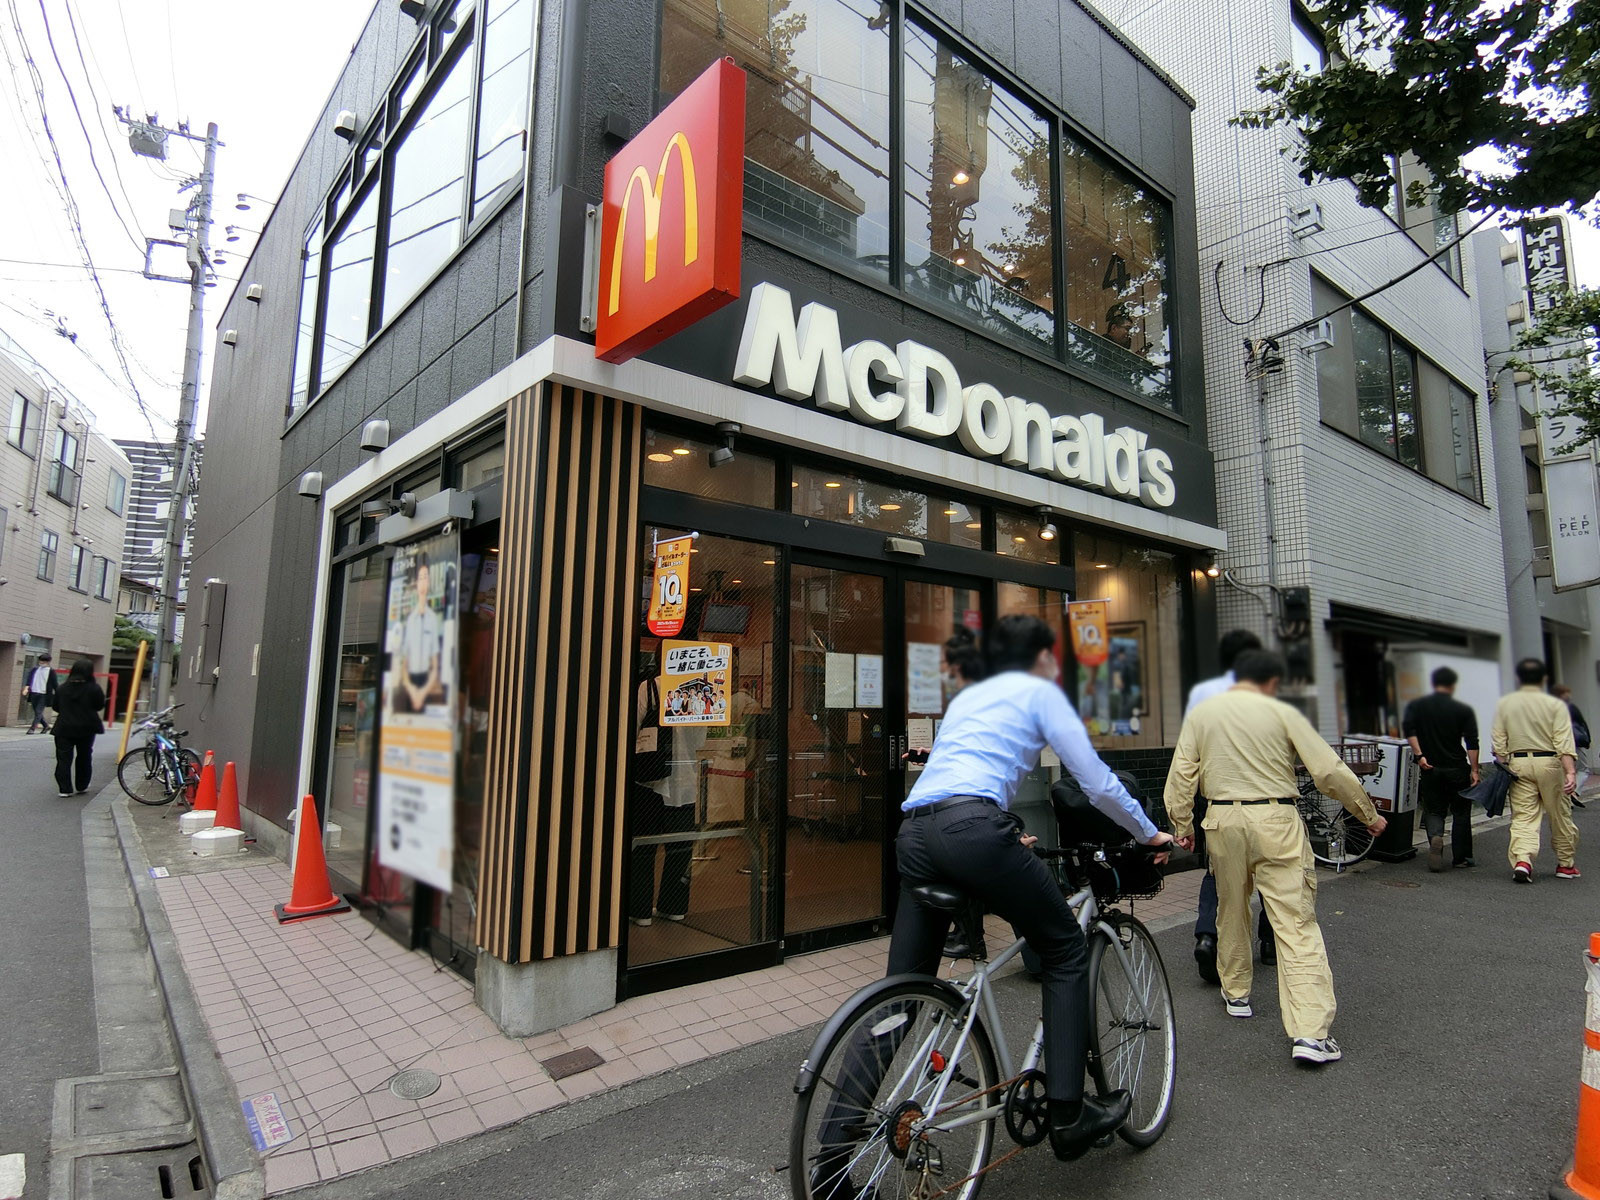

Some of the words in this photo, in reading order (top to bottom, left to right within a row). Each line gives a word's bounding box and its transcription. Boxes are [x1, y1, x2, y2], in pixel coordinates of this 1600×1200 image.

[733, 281, 1176, 508] McDonald's
[1559, 520, 1590, 532] PEP
[1560, 530, 1590, 538] SALON
